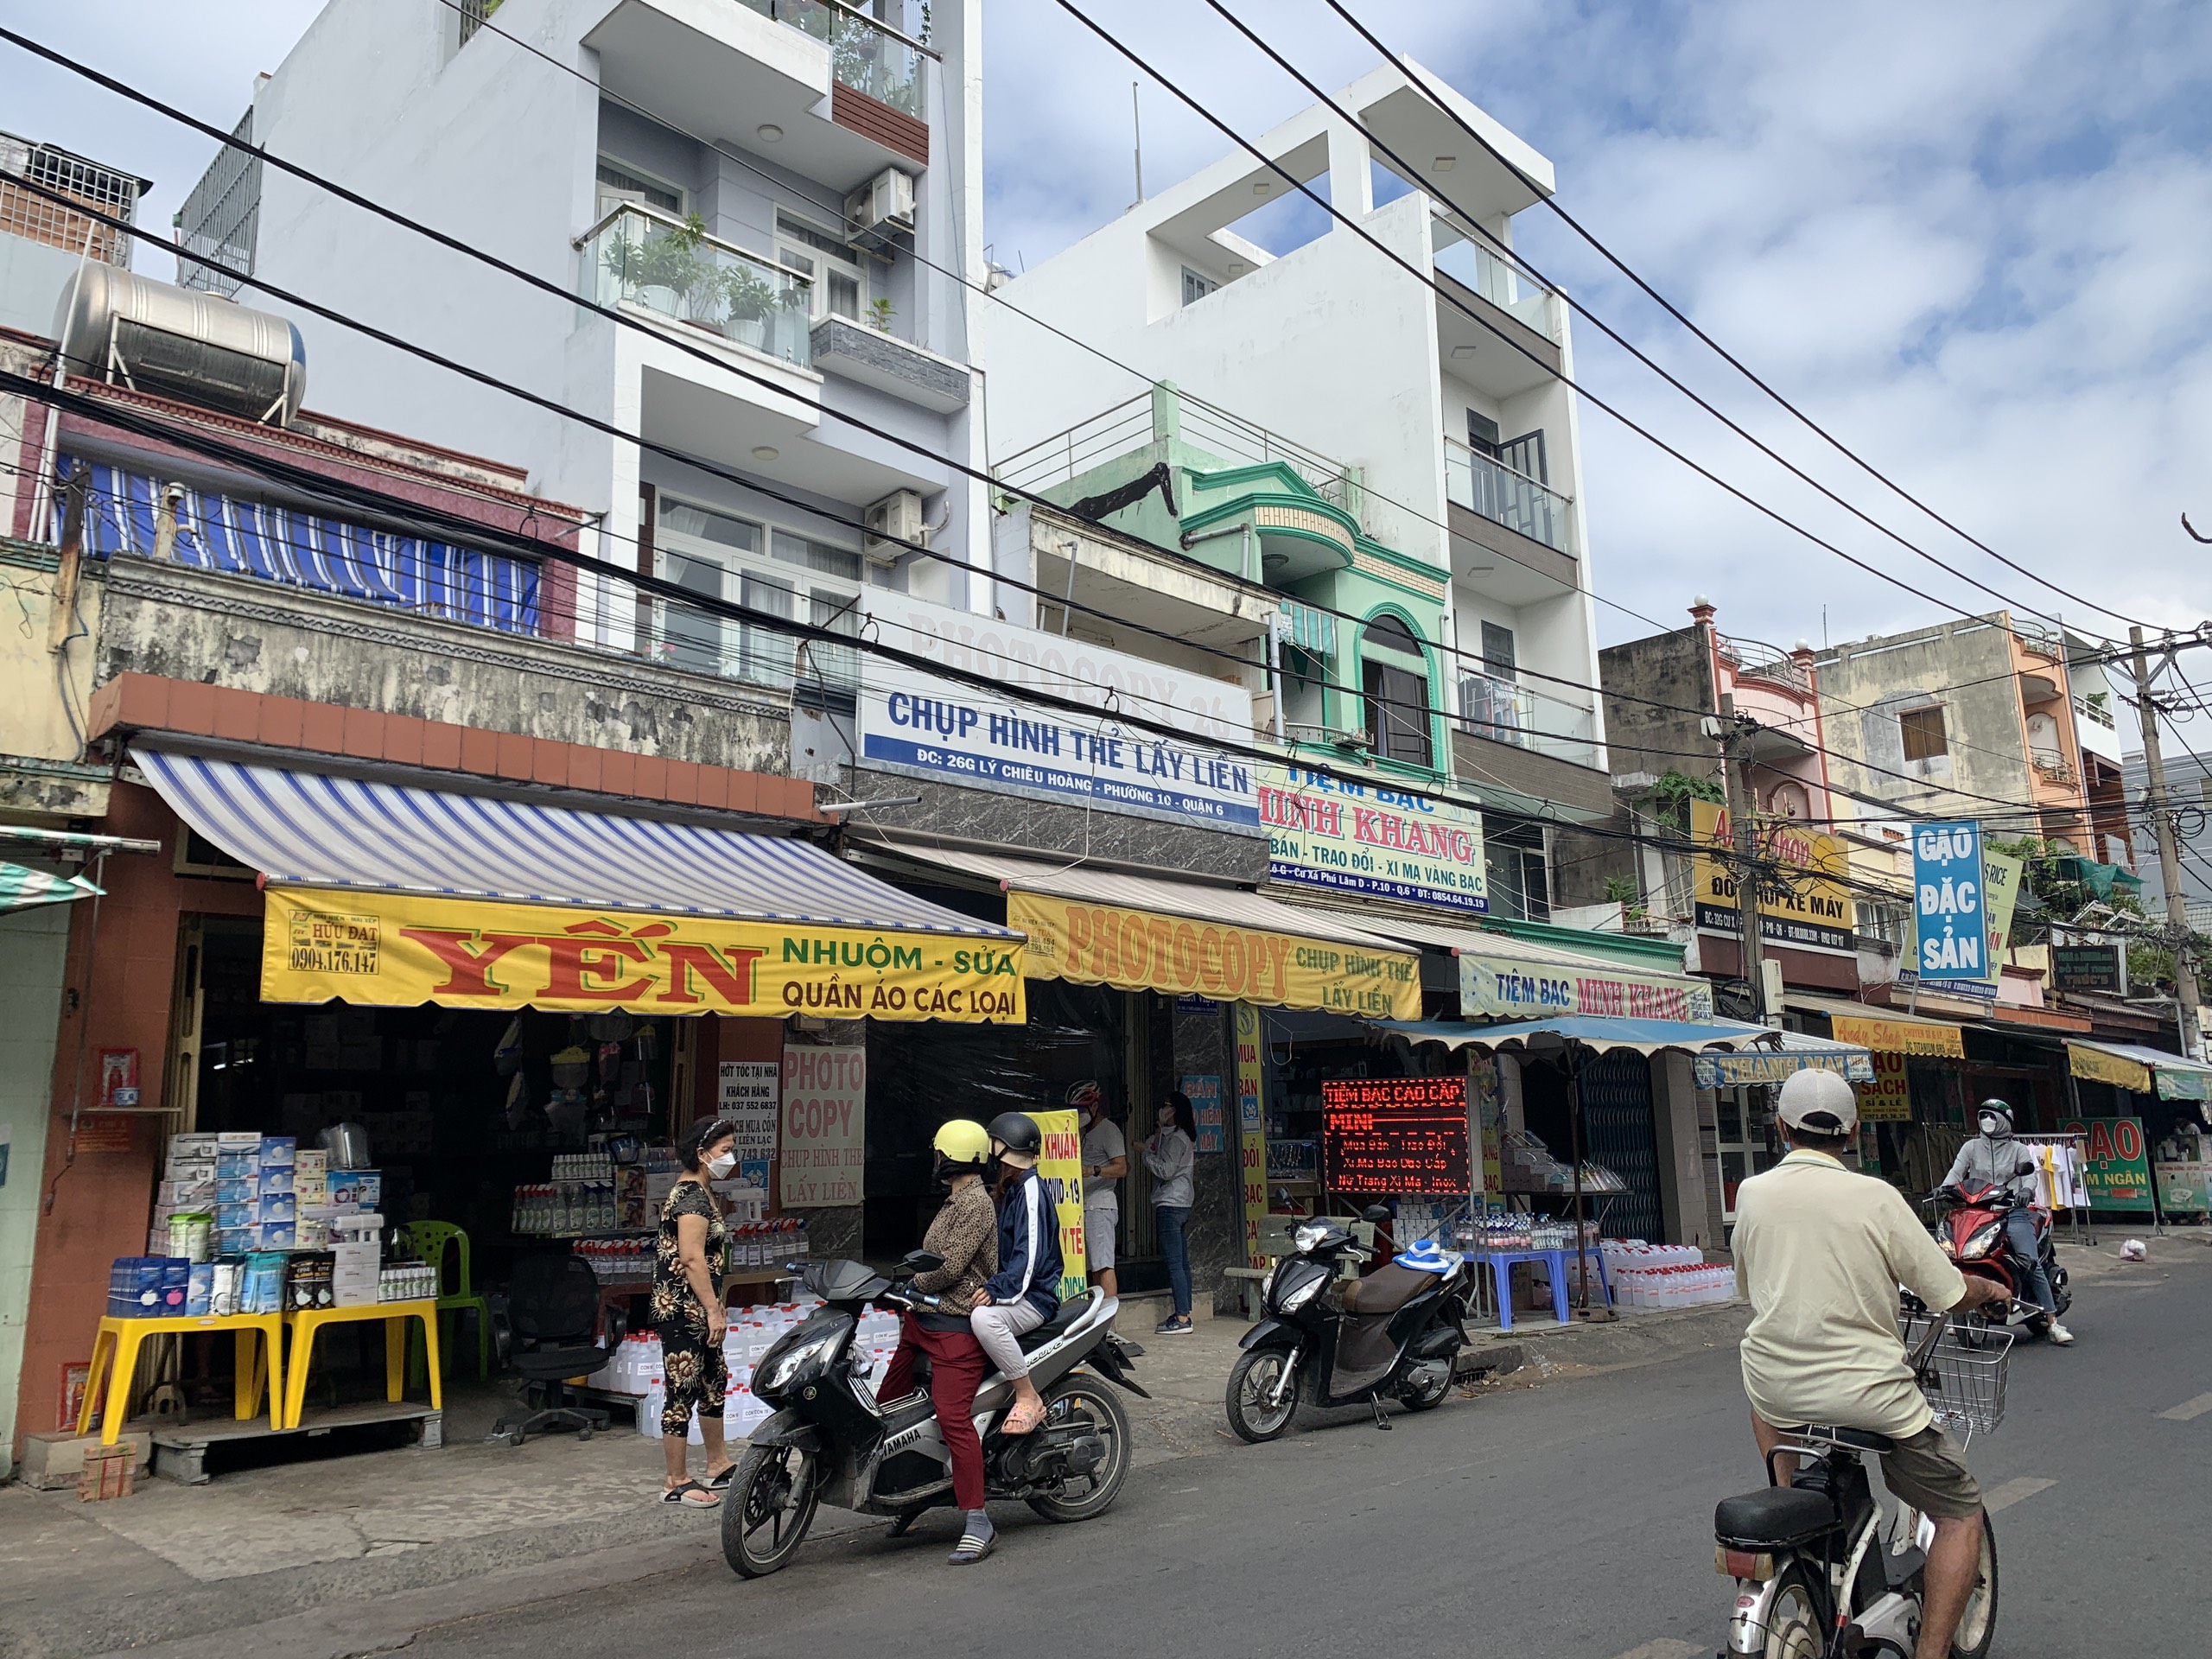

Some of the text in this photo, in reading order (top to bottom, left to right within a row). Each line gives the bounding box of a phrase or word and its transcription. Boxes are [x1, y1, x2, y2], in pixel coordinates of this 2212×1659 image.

[906, 613, 1179, 725] PHOTOCOPY
[888, 691, 978, 742] CHỤP
[989, 709, 1060, 757] HÌNH
[1070, 727, 1124, 769] THẺ
[1135, 739, 1185, 781] LẤY
[917, 748, 1224, 816] ĐC: 26G LÝ CHIÊU HOÀNG PHƯỜNG 10 QUẬN 6
[1352, 805, 1476, 866] KHANG
[1917, 827, 1973, 867] GẠO
[1312, 845, 1347, 868] TRAO
[1351, 848, 1374, 873] ĐỔI
[1387, 860, 1398, 876] XI
[1402, 863, 1421, 884] MẠ
[1424, 864, 1456, 887] VÀNG
[1460, 874, 1483, 893] BẠC
[1991, 865, 2008, 887] RICE
[1307, 868, 1319, 880] Xá
[1320, 872, 1337, 883] Phú
[1338, 875, 1357, 888] Lâm
[1358, 878, 1365, 888] D
[1371, 880, 1390, 893] P.10
[1397, 886, 1410, 896] Q.6
[1418, 889, 1431, 899] ĐT:
[1432, 892, 1484, 909] 0854.64.19.19
[1920, 876, 1976, 923] ĐẶC
[1810, 895, 1844, 919] MÁY
[312, 920, 344, 939] HỮU
[348, 926, 378, 944] ĐẠT
[1923, 925, 1979, 970] SẢN
[291, 948, 377, 973] 0904.176.147
[398, 916, 769, 1007] YẾN
[783, 937, 923, 975] NHUỘM
[953, 944, 1017, 976] SỬA
[1065, 906, 1294, 1000] PHOTOCOPY
[1296, 946, 1415, 984] CHỤP HÌNH THẺ
[782, 973, 1016, 1020] QUẦN ÁO CÁC LOẠI
[1322, 984, 1394, 1014] LẤY LIỀN
[1495, 968, 1689, 1023] TIỆM BẠC MINH KHANG
[1838, 1020, 1869, 1046] Andy
[1872, 1022, 1901, 1049] Shop
[720, 1063, 778, 1079] HỚT TÓC TẠI NHÀ
[783, 1051, 864, 1091] PHOTO
[1719, 1056, 1801, 1082] THANH
[1872, 1052, 1902, 1078] ẠO
[726, 1083, 770, 1097] KHÁCH HÀNG
[1183, 1077, 1217, 1098] BÁN
[1394, 1086, 1425, 1102] CAO
[1860, 1079, 1907, 1099] SẠCH
[745, 1112, 776, 1133] MUA CỒN
[788, 1098, 853, 1139] COPY
[739, 1134, 755, 1145] LIÊN
[757, 1135, 772, 1147] LẠC
[741, 1148, 758, 1160] 743
[760, 1147, 776, 1160] 632
[813, 1143, 840, 1167] HÌNH
[843, 1140, 863, 1166] THẺ
[1044, 1119, 1077, 1160] KHUẨN
[786, 1171, 857, 1203] LẤY LIỀN
[1071, 1178, 1080, 1205] 19
[1357, 1174, 1387, 1188] Trang
[1389, 1175, 1402, 1187] Xi
[1432, 1176, 1457, 1188] Inox
[2105, 1172, 2146, 1185] NGÂN
[1062, 1215, 1084, 1255] Y TẾ
